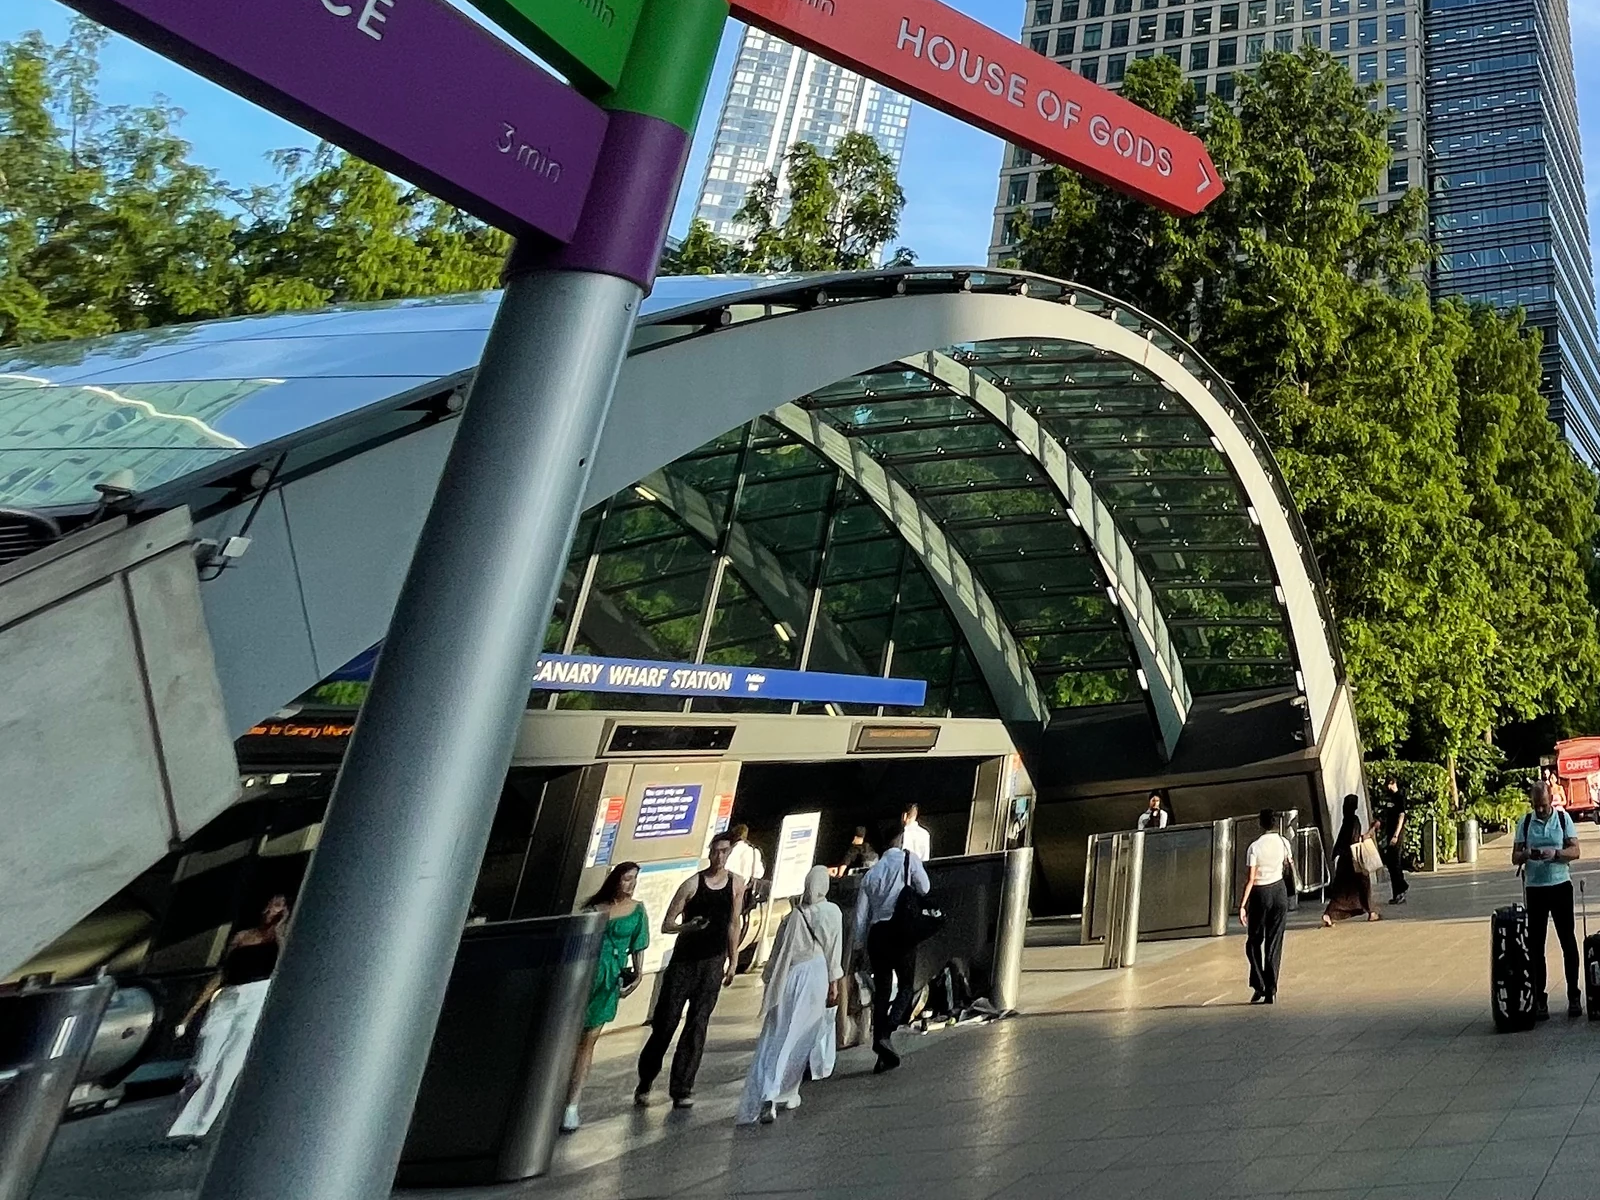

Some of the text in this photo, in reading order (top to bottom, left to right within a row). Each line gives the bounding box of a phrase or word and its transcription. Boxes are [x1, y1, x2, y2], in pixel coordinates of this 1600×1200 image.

[896, 16, 1029, 108] HOUSE
[1036, 89, 1084, 130] OF
[1088, 115, 1175, 177] GODS
[497, 122, 563, 184] 3 min
[608, 664, 669, 687] WHARF
[670, 669, 733, 691] STATION
[1566, 759, 1594, 771] COFFEE
